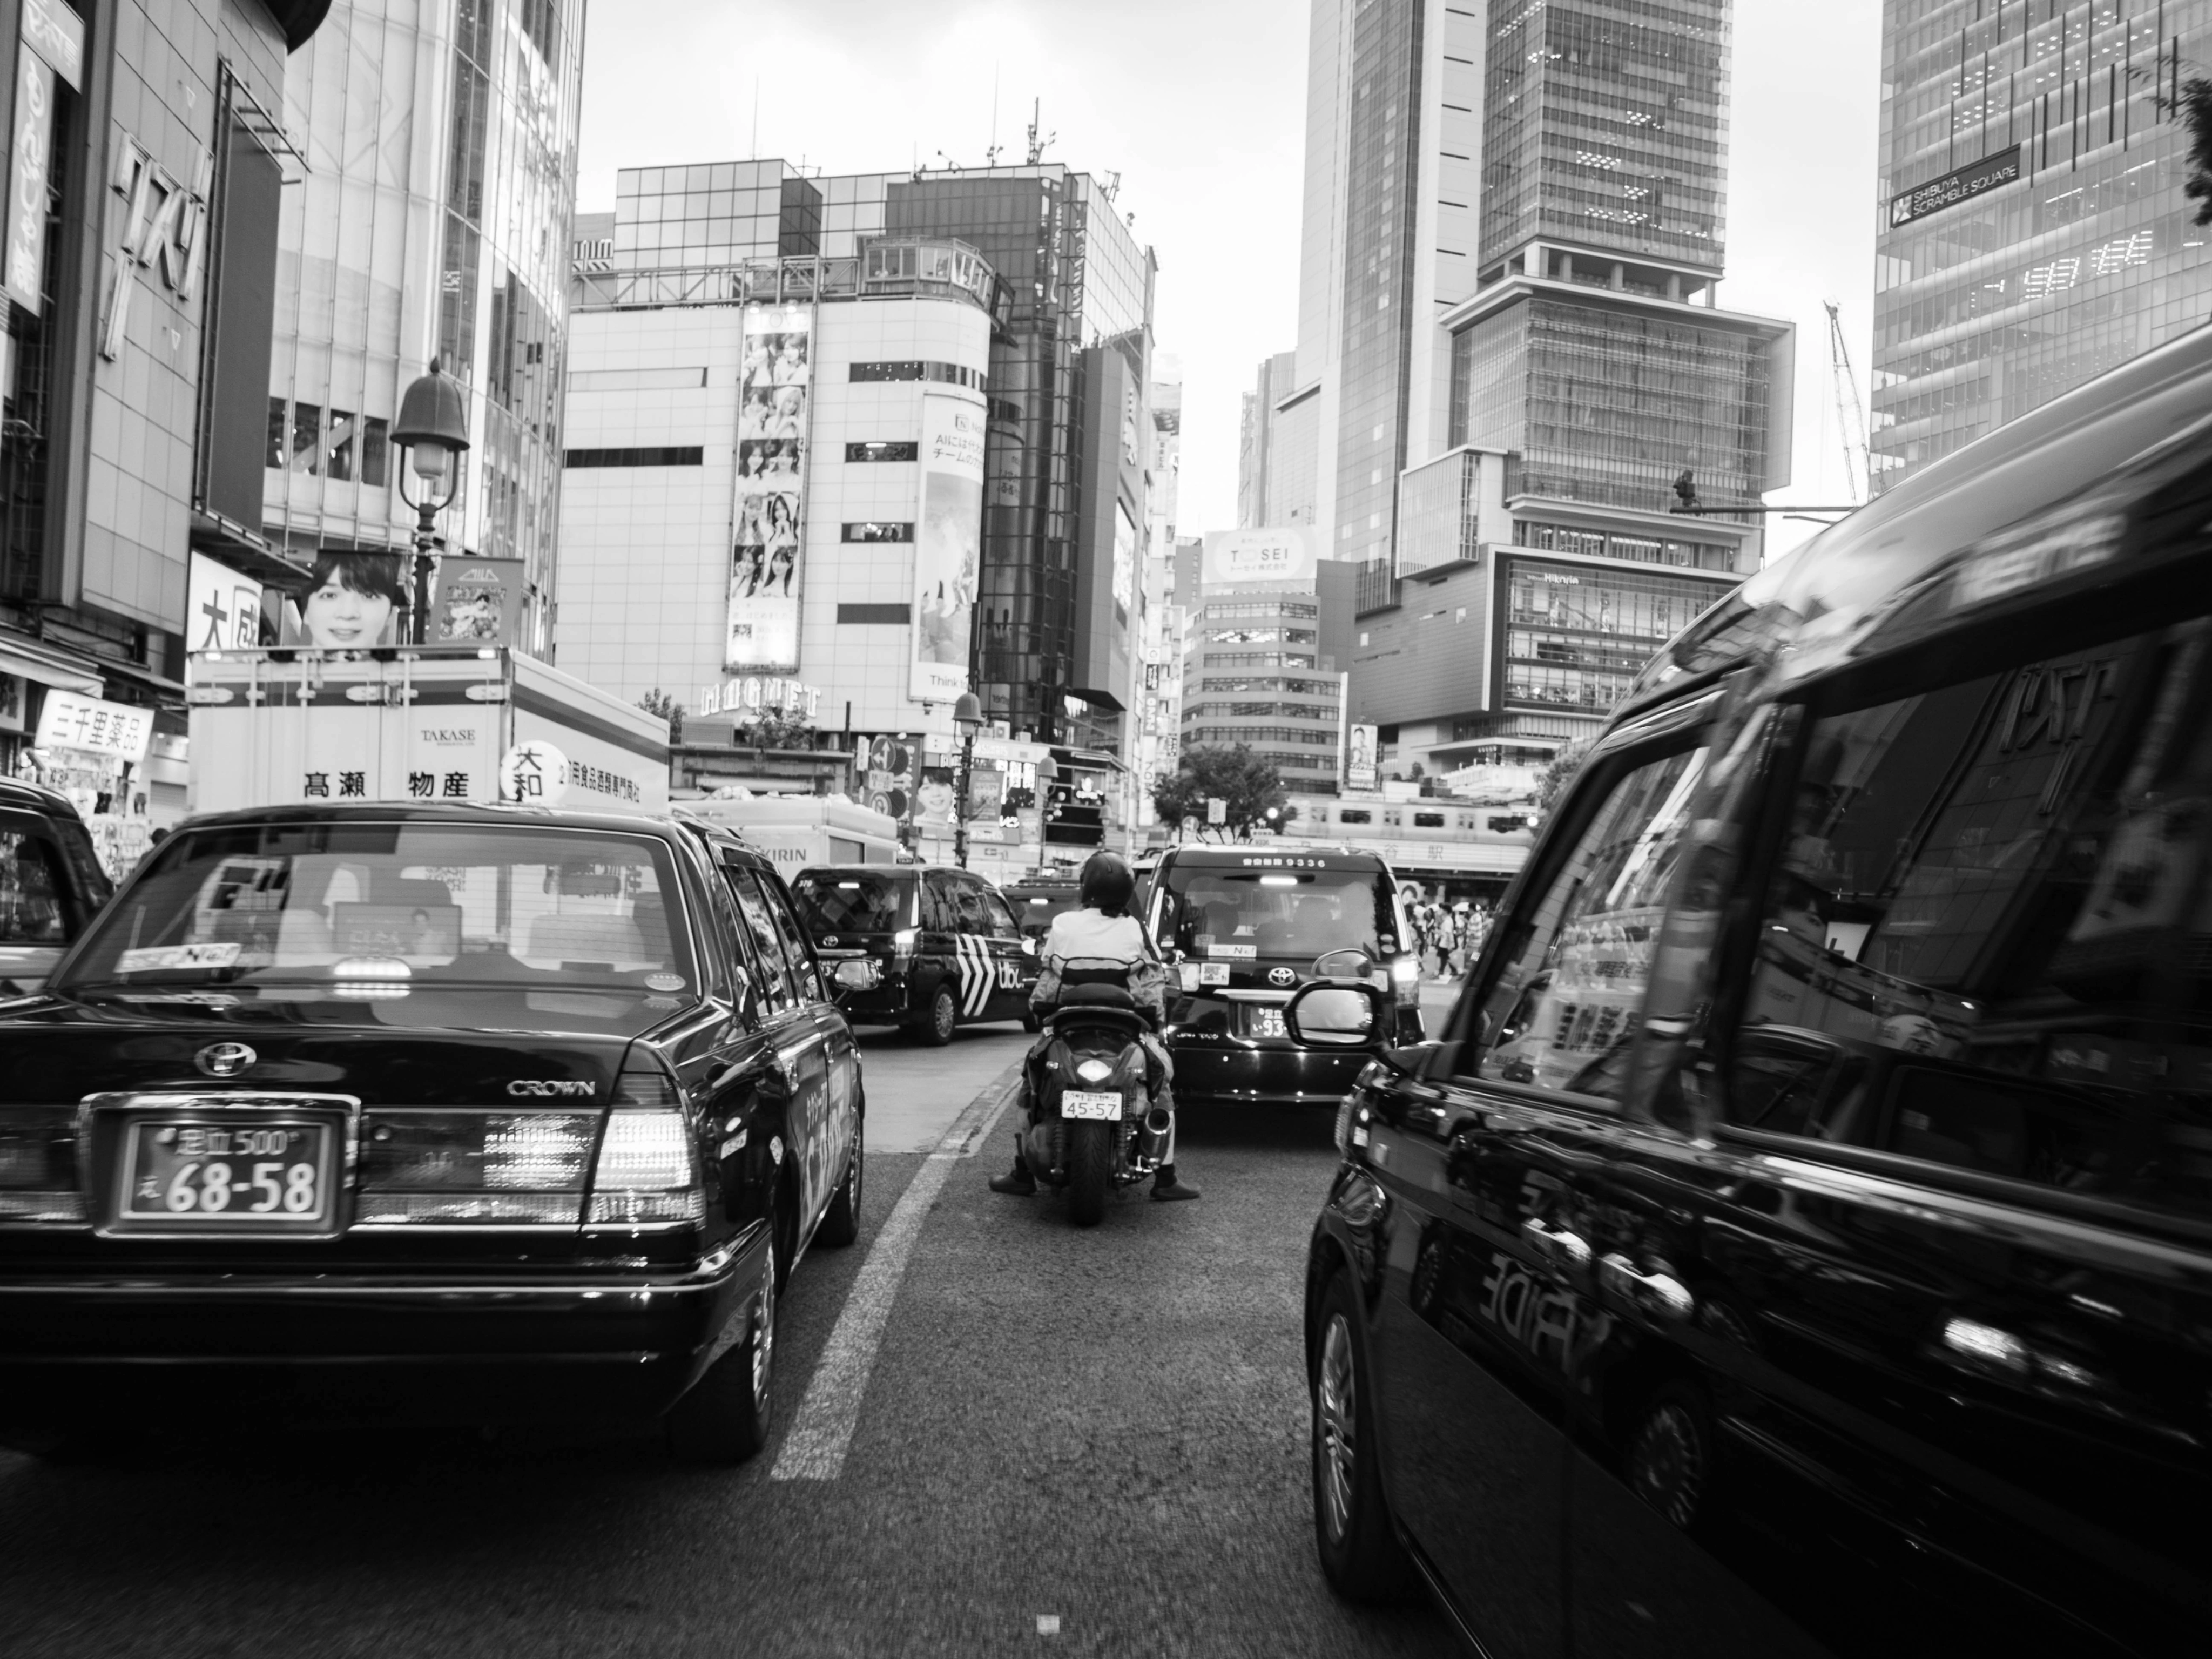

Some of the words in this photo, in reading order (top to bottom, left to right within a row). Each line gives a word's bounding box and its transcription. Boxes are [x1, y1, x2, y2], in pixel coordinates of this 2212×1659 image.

[1913, 186, 1968, 215] SCRAMBLE
[1971, 164, 2016, 191] SQUARE
[1913, 177, 1959, 203] SHIBUYA
[930, 675, 959, 688] Think
[700, 677, 821, 717] MAGNET
[52, 703, 141, 751] 三千里薬品
[421, 729, 476, 741] TAKASE
[408, 771, 469, 798] 物産
[512, 747, 543, 800] 大和
[507, 1080, 596, 1097] CROWN
[1067, 1102, 1117, 1117] 45-57
[176, 1129, 231, 1156] 足立
[232, 1130, 288, 1156] 500
[166, 1162, 316, 1212] 68-58
